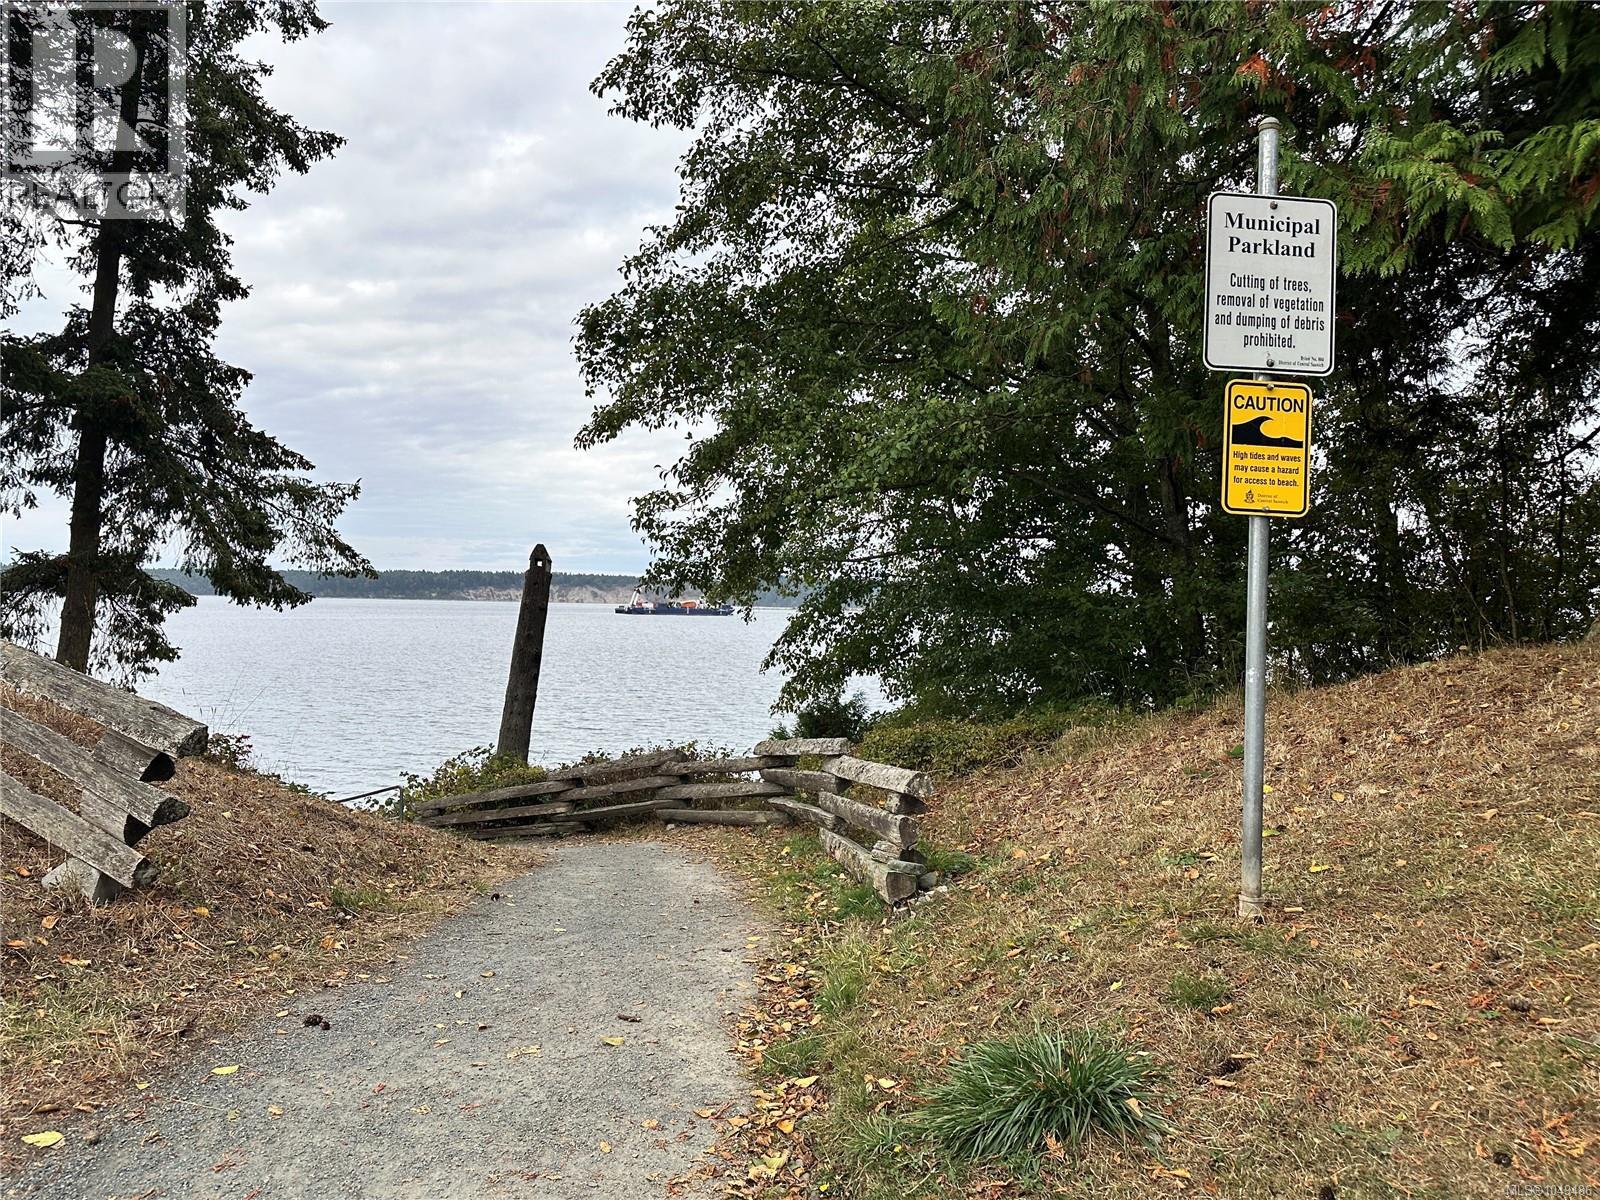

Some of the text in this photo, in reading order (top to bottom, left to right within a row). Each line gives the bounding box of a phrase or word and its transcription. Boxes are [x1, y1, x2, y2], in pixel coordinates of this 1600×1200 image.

[1224, 212, 1320, 238] Municipal
[1228, 236, 1315, 258] Parkland
[1230, 273, 1312, 293] Cutting of trees,
[1216, 294, 1324, 312] removal of vegetation
[1215, 311, 1325, 331] and dumping of debris
[1243, 332, 1296, 349] prohibited.
[1233, 394, 1304, 413] CAUTION
[1233, 451, 1248, 460] High
[1249, 452, 1266, 460] tides
[1267, 453, 1279, 461] and
[1234, 464, 1249, 473] may
[1250, 465, 1269, 473] cause
[1277, 466, 1300, 474] hazard
[1244, 477, 1267, 485] access
[1277, 478, 1299, 487] beach.
